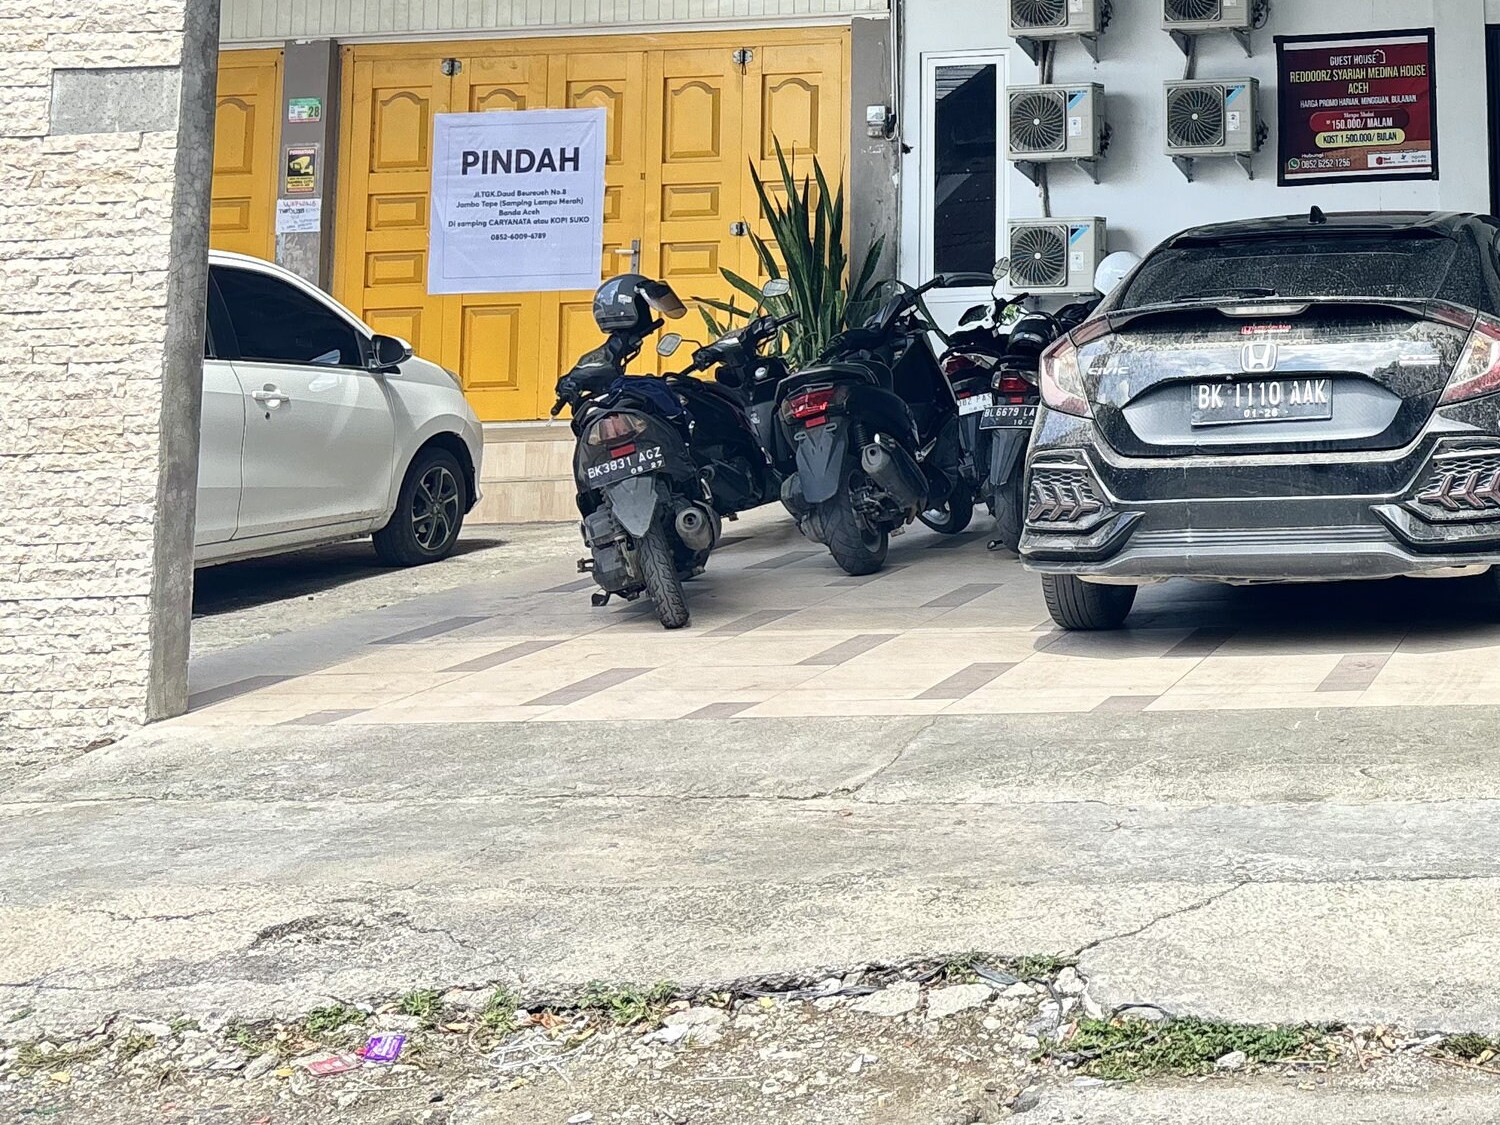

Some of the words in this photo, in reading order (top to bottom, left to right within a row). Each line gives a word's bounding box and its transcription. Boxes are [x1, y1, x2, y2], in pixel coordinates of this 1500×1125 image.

[1330, 56, 1351, 66] GUEST
[1353, 54, 1376, 65] HOUSE
[1290, 70, 1331, 83] REDDOORZ
[1333, 68, 1366, 80] SYARIAH
[1368, 66, 1398, 78] MEDINA
[1400, 64, 1426, 76] HOUSE
[1348, 82, 1369, 94] ACEH
[308, 105, 320, 117] 28
[1367, 117, 1392, 128] MALAM
[1323, 135, 1338, 144] KOST
[1377, 132, 1397, 141] BULAN
[462, 147, 579, 175] PINDAH
[1301, 159, 1317, 169] 0852
[1318, 158, 1333, 168] 6252
[534, 198, 557, 207] Lampu
[559, 197, 583, 205] Merah)
[498, 208, 521, 216] Banda
[488, 218, 531, 226] CARYANATA
[1087, 366, 1129, 375] CIVIC
[1199, 384, 1224, 409] BK
[1236, 382, 1280, 407] 1110
[1290, 379, 1328, 405] AAK
[985, 408, 995, 417] BL
[996, 408, 1019, 417] 6679
[639, 446, 662, 462] AGZ
